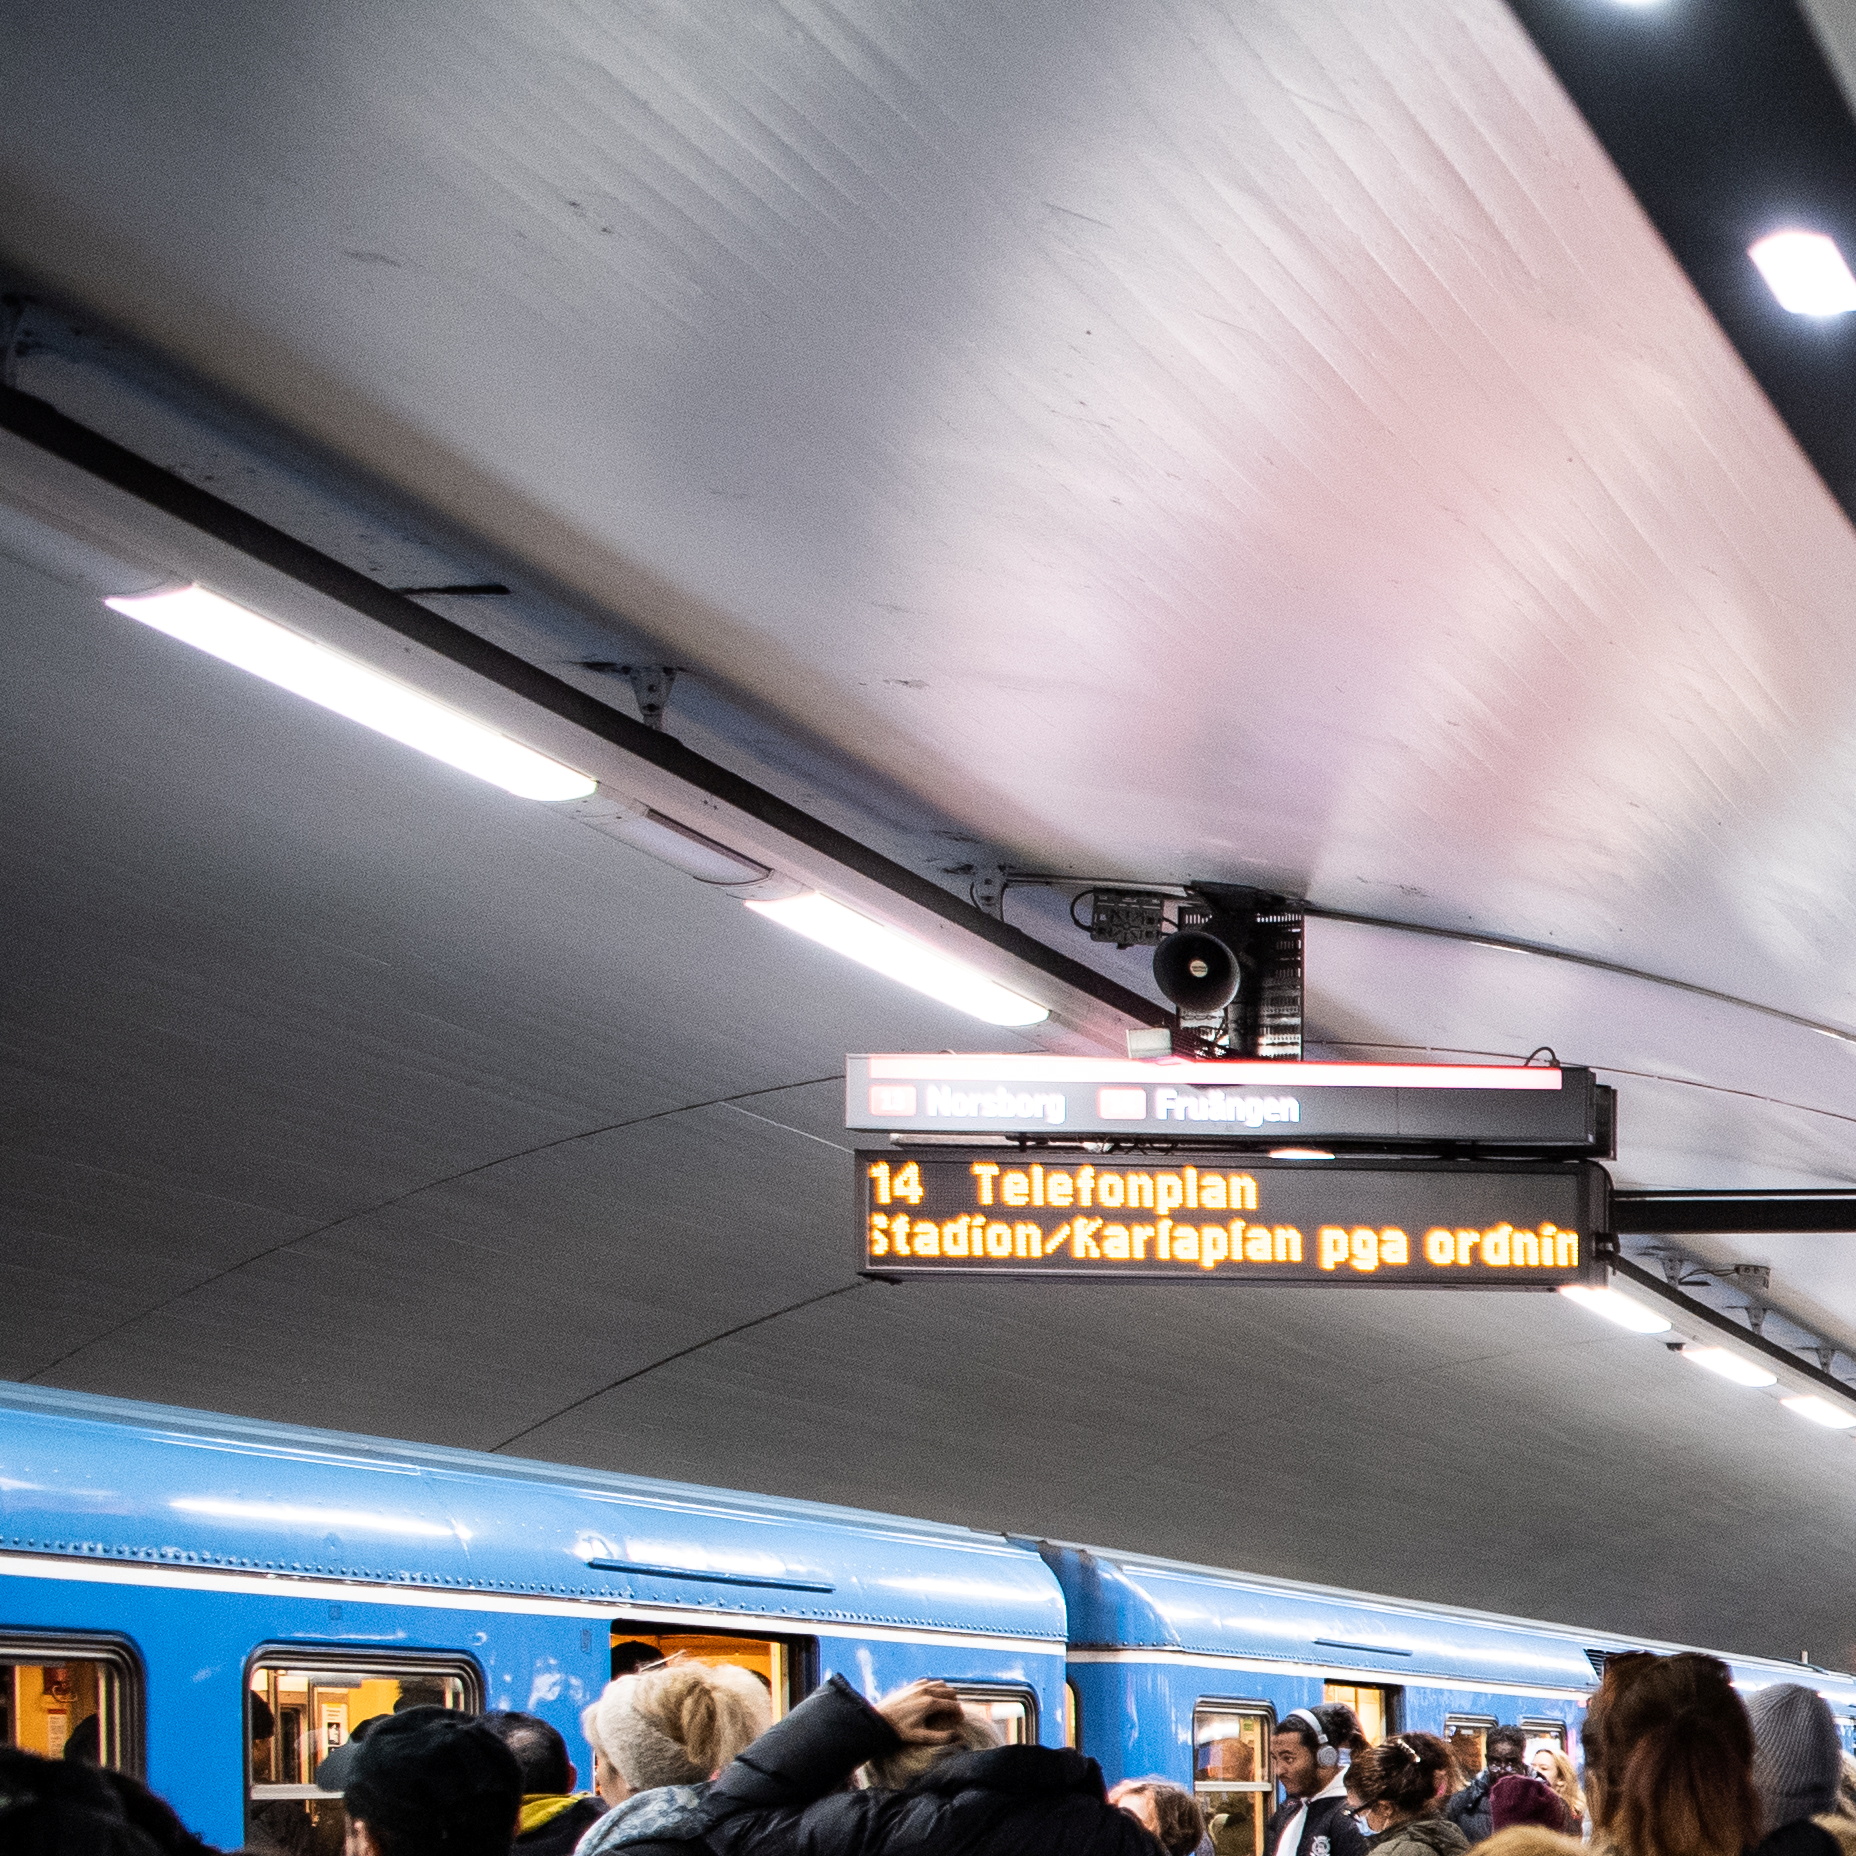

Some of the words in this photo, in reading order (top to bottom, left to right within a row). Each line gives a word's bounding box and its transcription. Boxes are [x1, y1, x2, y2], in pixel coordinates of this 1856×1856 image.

[926, 1083, 1067, 1125] Norsborg
[1155, 1087, 1301, 1128] Fruängen
[868, 1160, 925, 1206] 14
[969, 1161, 1260, 1216] Telefonplan
[869, 1212, 1303, 1270] Stadion/Karlaplan
[1316, 1224, 1410, 1272] pga
[1423, 1221, 1579, 1267] ordnin
